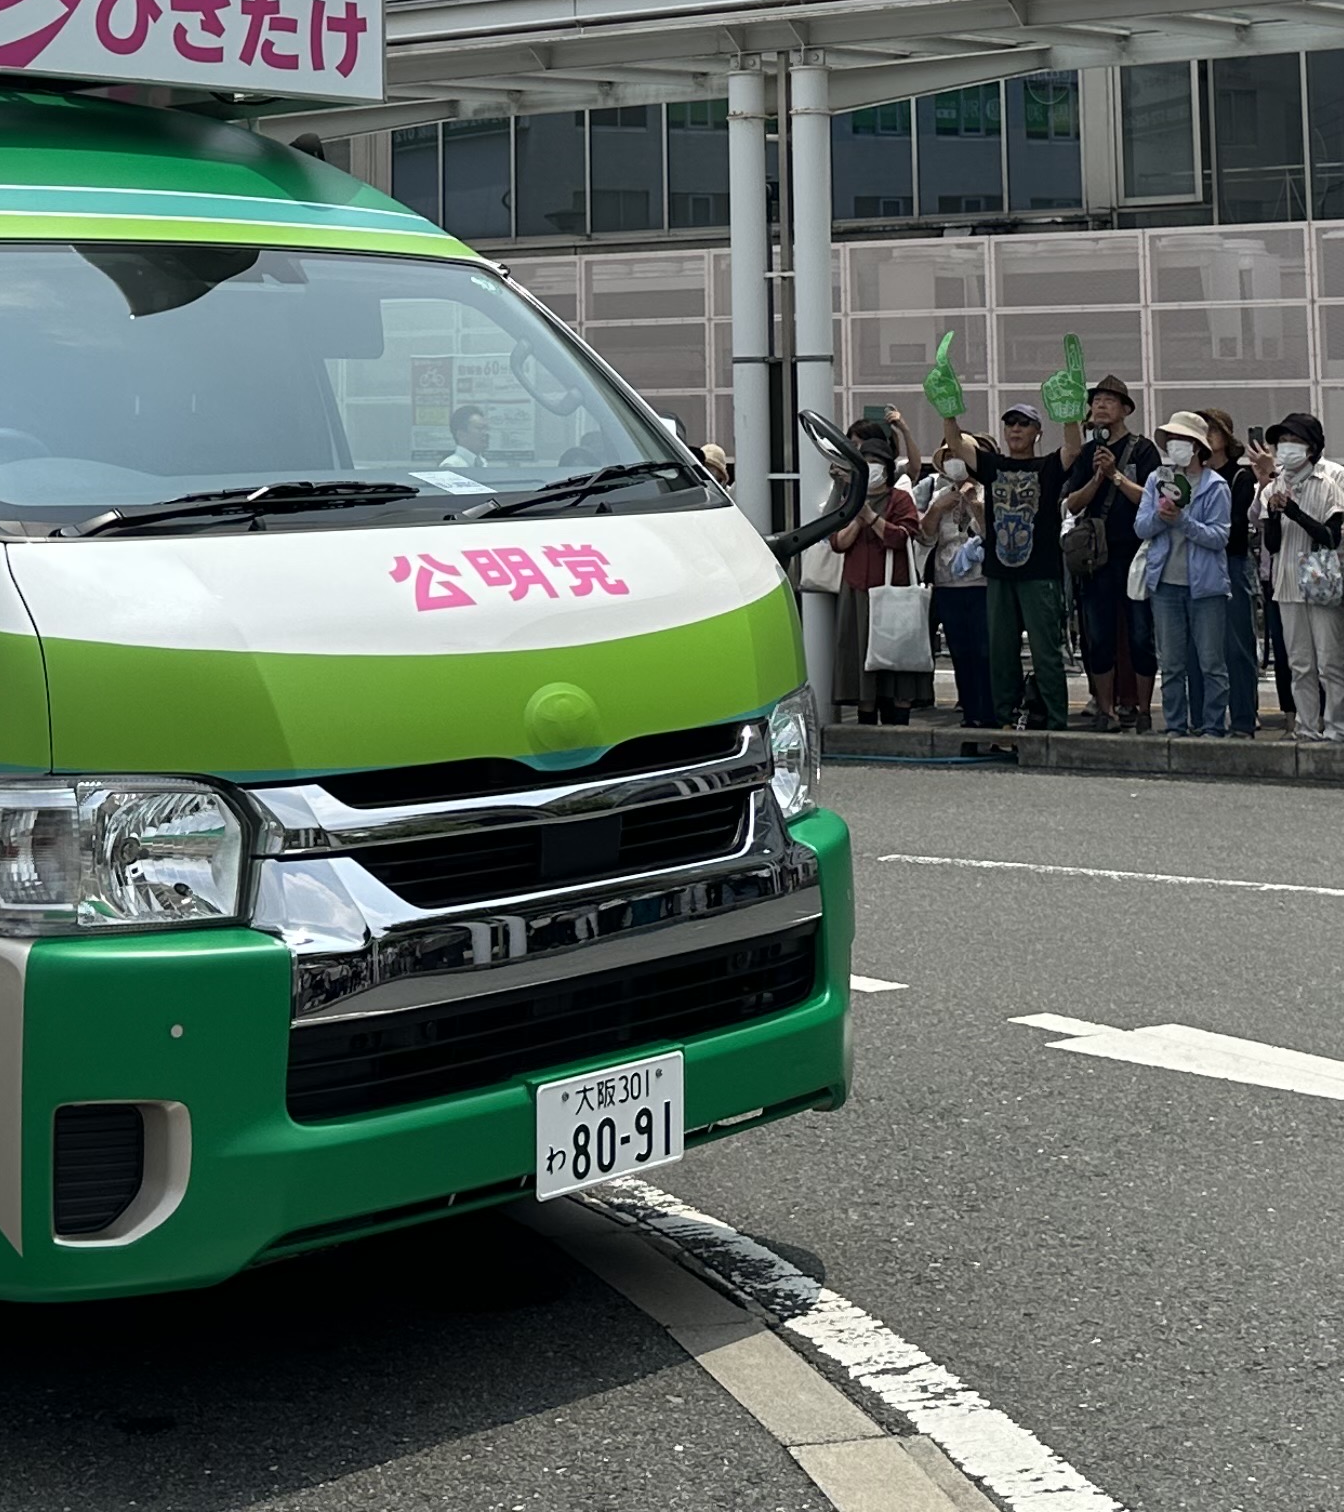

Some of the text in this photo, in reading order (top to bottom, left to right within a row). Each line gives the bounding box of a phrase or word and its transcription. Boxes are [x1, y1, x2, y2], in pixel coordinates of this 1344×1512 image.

[389, 544, 630, 612] 公明党
[545, 1100, 672, 1180] わ 80-91
